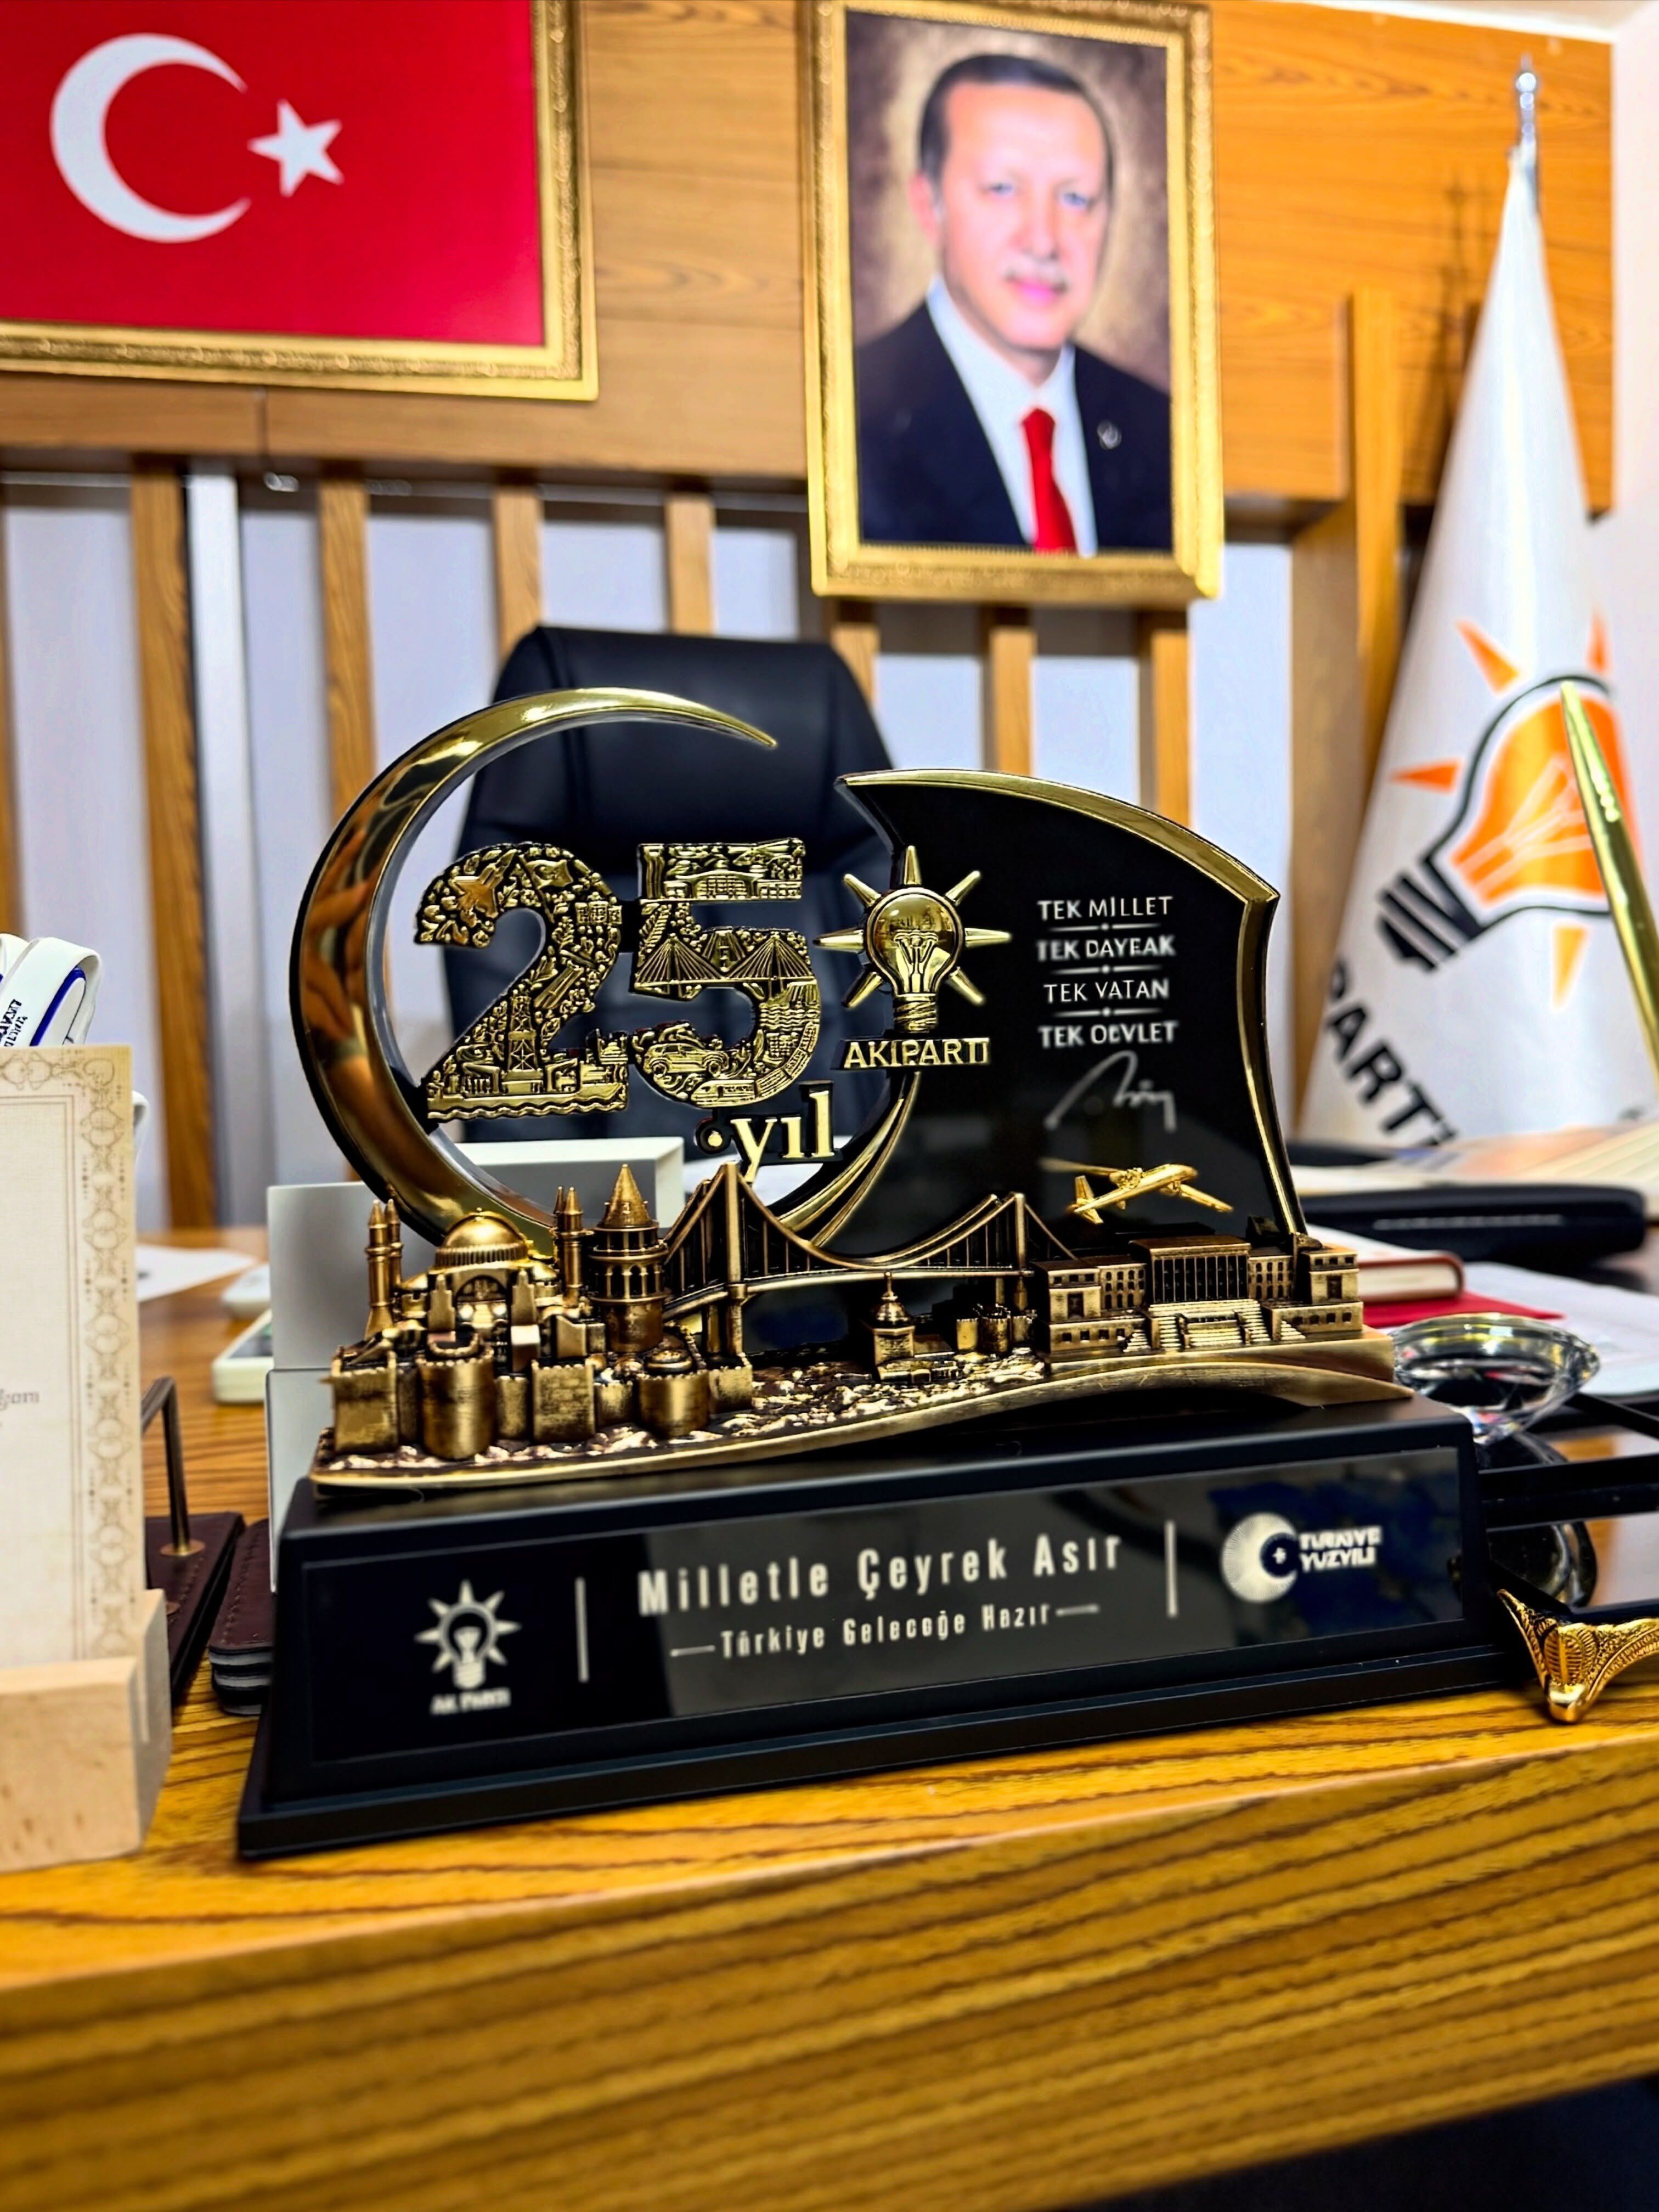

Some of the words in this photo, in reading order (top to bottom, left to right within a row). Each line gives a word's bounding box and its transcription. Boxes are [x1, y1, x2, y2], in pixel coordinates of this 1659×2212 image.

[1037, 900, 1081, 920] TEK
[1037, 940, 1079, 961] TEK
[415, 839, 821, 1119] 25
[1043, 983, 1087, 1003] TEK
[1095, 979, 1169, 999] VATAN
[1040, 1026, 1083, 1048] TEK
[639, 1556, 829, 1616] Milletle
[857, 1537, 1007, 1601] Çeyrek
[1032, 1533, 1120, 1577] Asır
